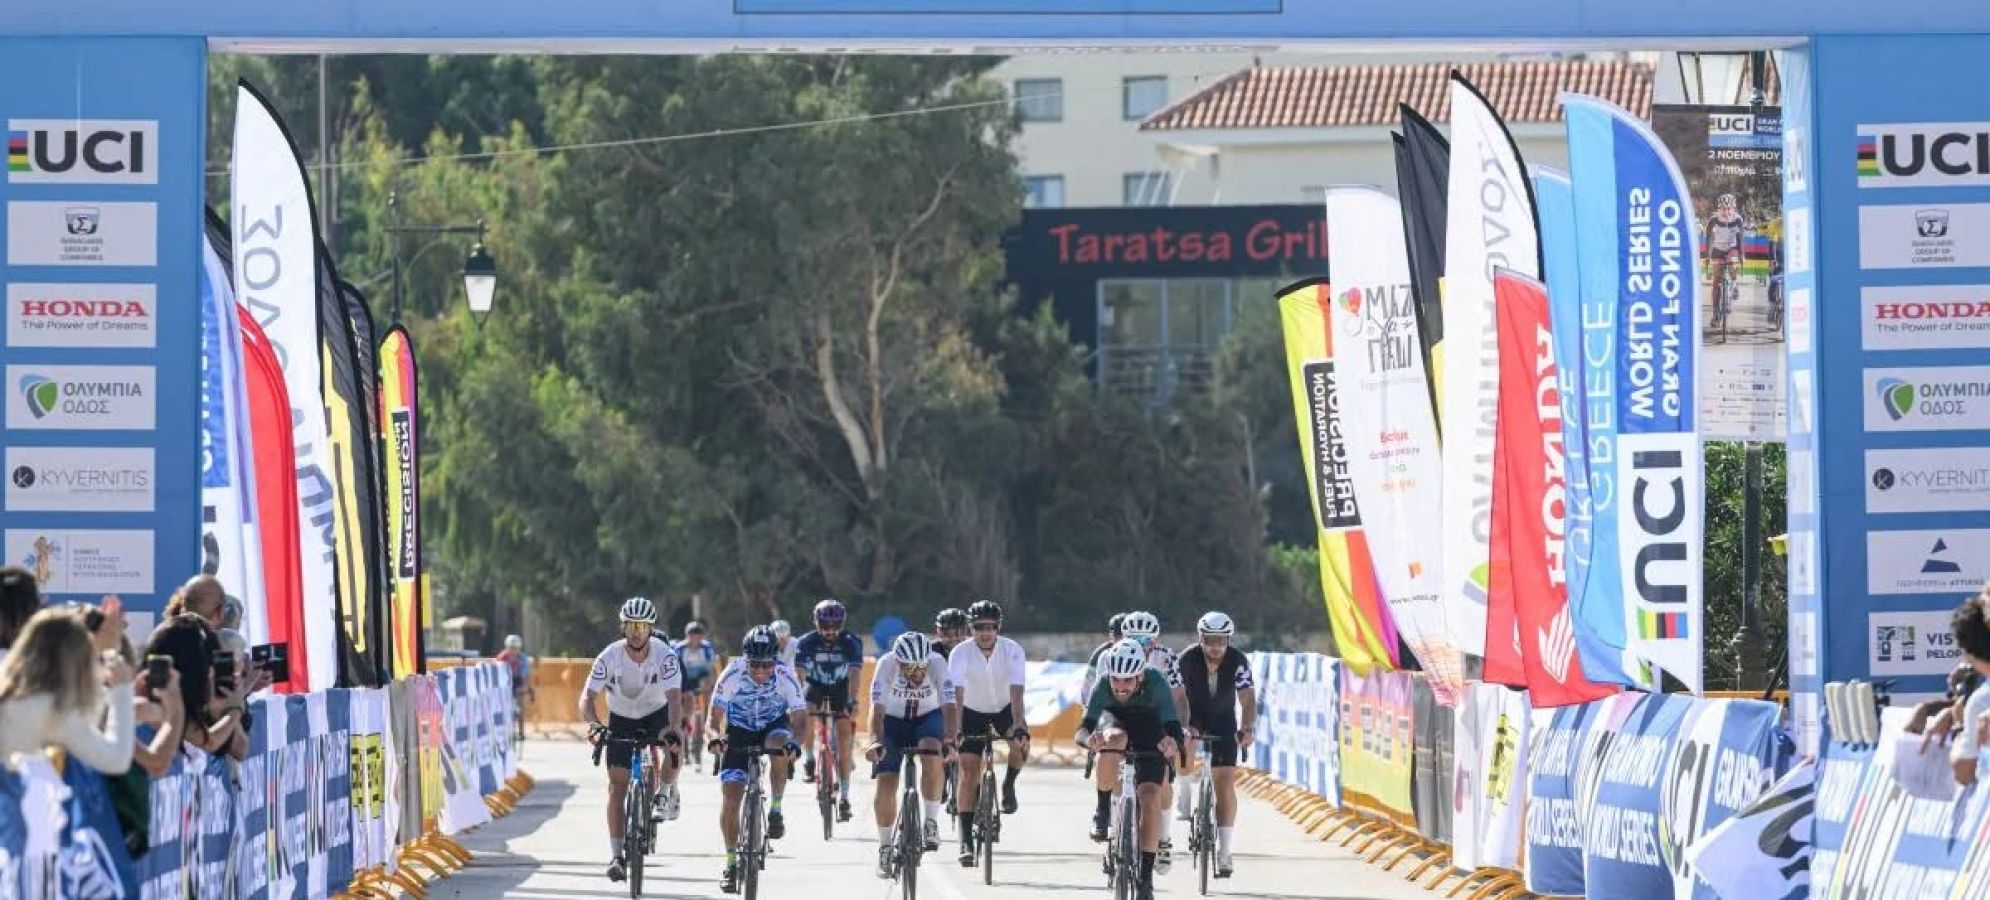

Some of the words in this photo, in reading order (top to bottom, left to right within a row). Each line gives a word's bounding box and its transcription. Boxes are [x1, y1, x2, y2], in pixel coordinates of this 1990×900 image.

[1718, 117, 1750, 132] UCI
[34, 130, 144, 173] UCI
[1708, 150, 1715, 160] 2
[1882, 132, 1990, 177] UCI
[1048, 222, 1232, 264] Taratsa
[1246, 218, 1329, 261] Gril
[21, 300, 149, 317] HONDA
[1875, 302, 1990, 319] HONDA
[22, 320, 45, 330] The
[47, 320, 84, 330] Power
[87, 320, 100, 330] of
[102, 320, 149, 331] Dreams
[1878, 323, 1898, 332] The
[1901, 321, 1937, 332] Power
[1940, 321, 1953, 331] of
[1956, 320, 1990, 331] Dream
[63, 382, 142, 397] ΟΛΥΜΠΙΑ
[63, 399, 111, 414] ΟΔΟΣ
[1920, 400, 1967, 415] ΟΔΟΣ
[41, 470, 148, 486] KYVERNITIS
[1900, 468, 1990, 486] KYVERNIT
[1926, 633, 1953, 646] VIS
[1926, 649, 1963, 659] PELOP
